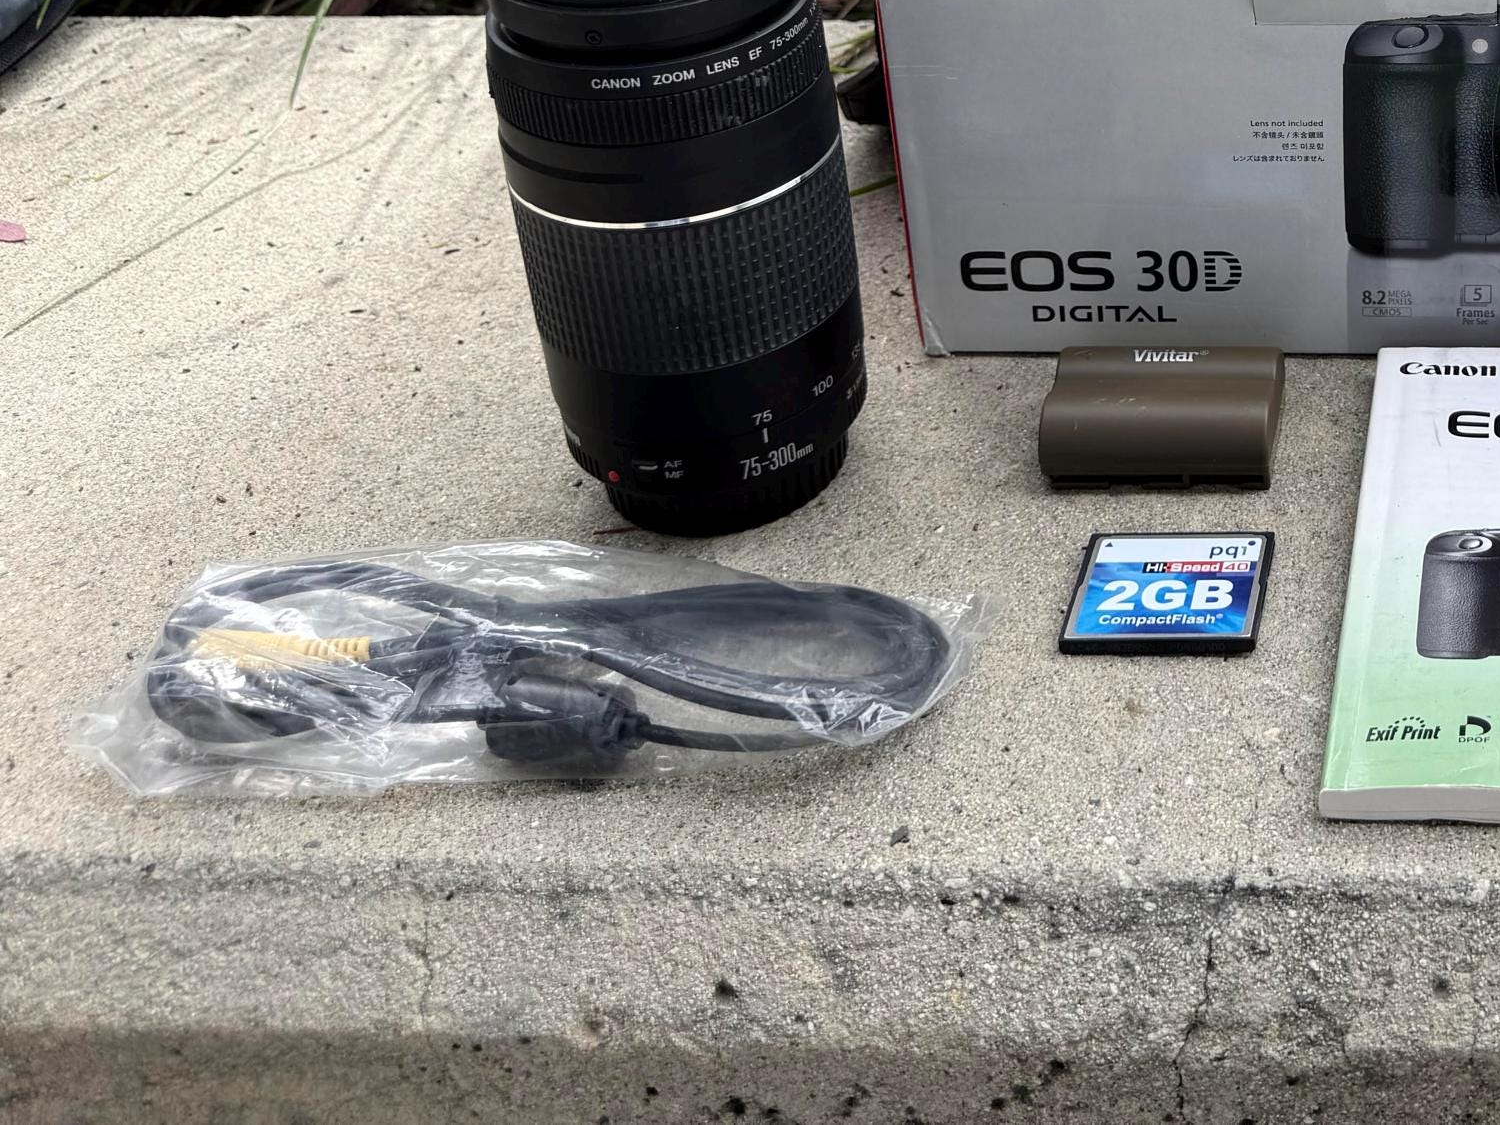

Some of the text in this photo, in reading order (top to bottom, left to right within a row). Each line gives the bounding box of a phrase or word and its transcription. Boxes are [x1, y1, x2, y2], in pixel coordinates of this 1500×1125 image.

[591, 16, 808, 89] CANON ZOOM LENS EF 75-300mm
[960, 250, 1243, 292] EOS 30D
[1362, 290, 1412, 305] 8.2 MEGA
[1388, 298, 1413, 306] PIXELS
[1473, 287, 1482, 301] 5
[1032, 305, 1177, 323] DIGITAL
[1372, 308, 1402, 316] CMOS
[1456, 308, 1495, 318] Frames
[1399, 361, 1497, 377] Canon
[752, 409, 773, 426] 75
[812, 375, 834, 397] 100
[664, 460, 683, 469] AF
[740, 442, 814, 480] 75-300mm
[664, 470, 684, 479] MF
[1096, 579, 1234, 611] 2GB
[1366, 725, 1441, 742] Exif Print
